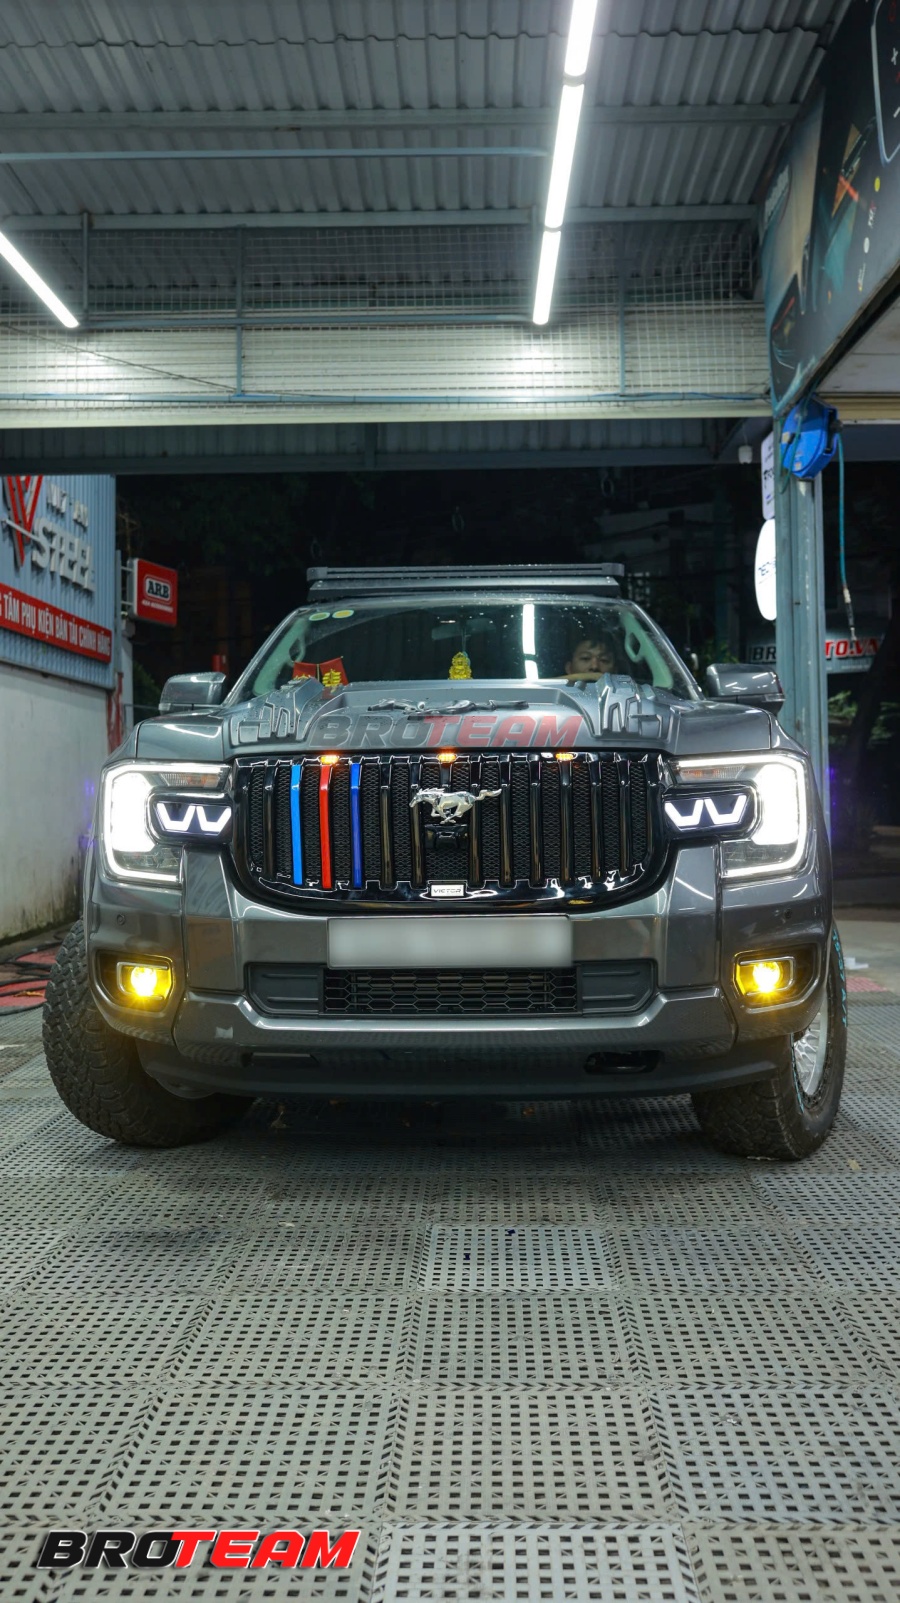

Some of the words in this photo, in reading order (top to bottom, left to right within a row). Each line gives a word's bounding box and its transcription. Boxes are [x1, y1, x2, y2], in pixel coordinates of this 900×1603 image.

[32, 517, 97, 594] STEEL
[147, 580, 170, 599] ARB
[21, 601, 36, 635] PHỤ
